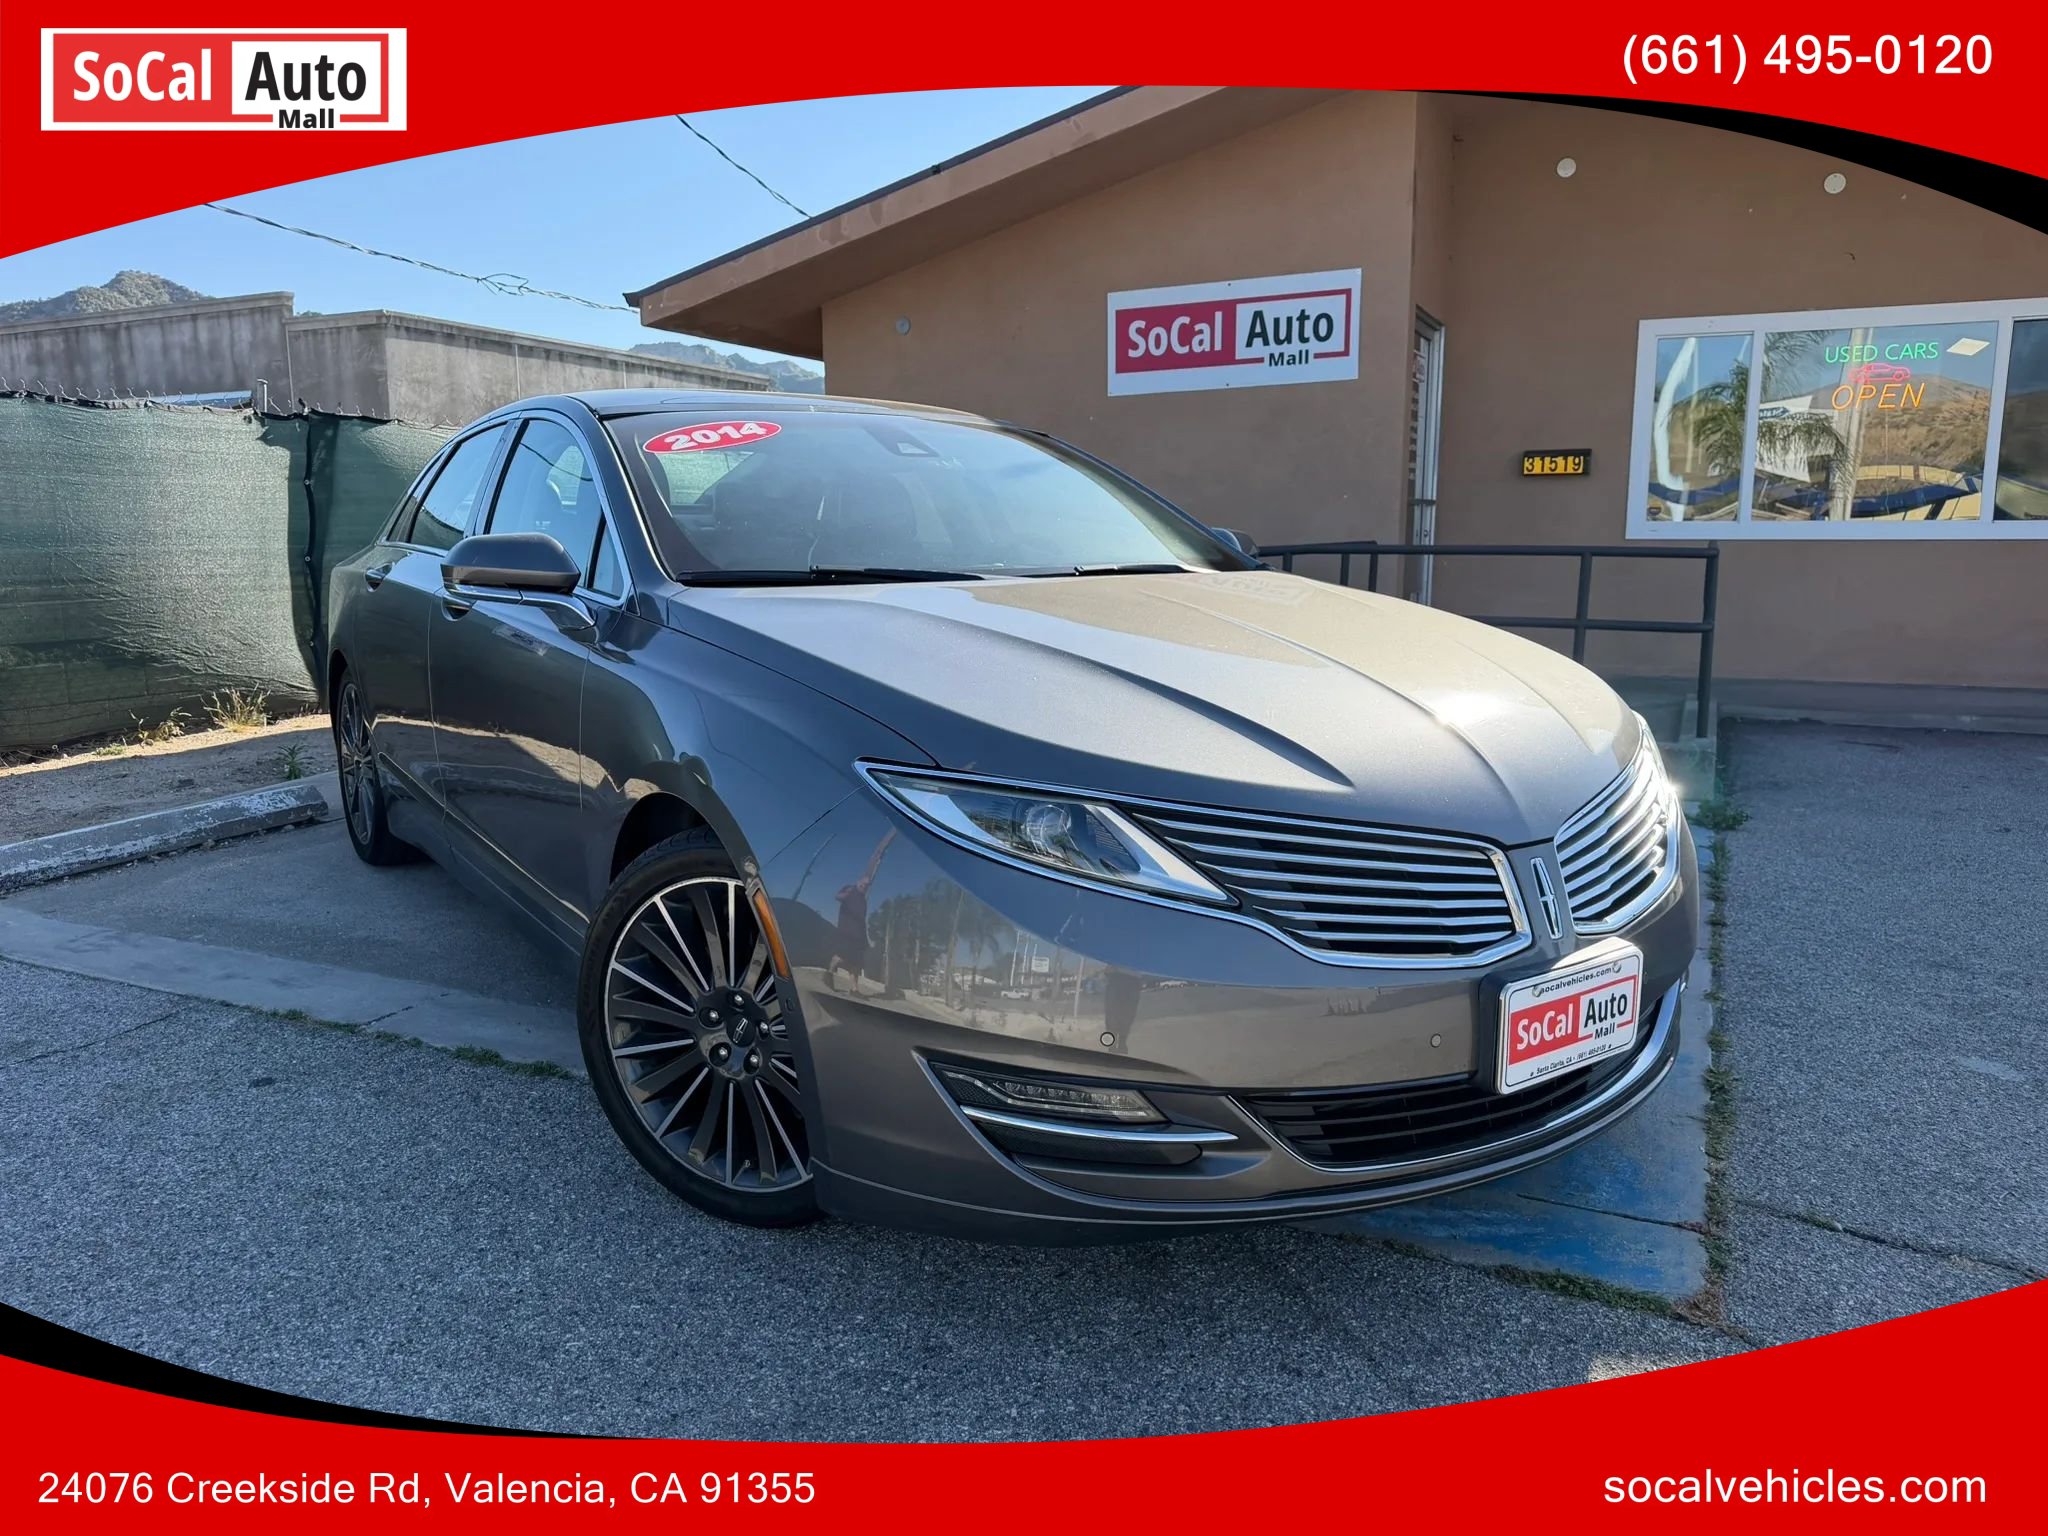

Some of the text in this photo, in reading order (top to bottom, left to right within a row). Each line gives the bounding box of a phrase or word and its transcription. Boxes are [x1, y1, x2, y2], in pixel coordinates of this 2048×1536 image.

[1127, 309, 1334, 358] SoCal Auto
[1268, 350, 1309, 367] Mall
[1825, 342, 1939, 363] USED CARS
[1831, 382, 1926, 410] OPEN
[664, 422, 767, 450] 2014
[1526, 456, 1582, 472] 31519
[1516, 991, 1628, 1051] SoCal Auto
[1594, 1022, 1615, 1040] Mall
